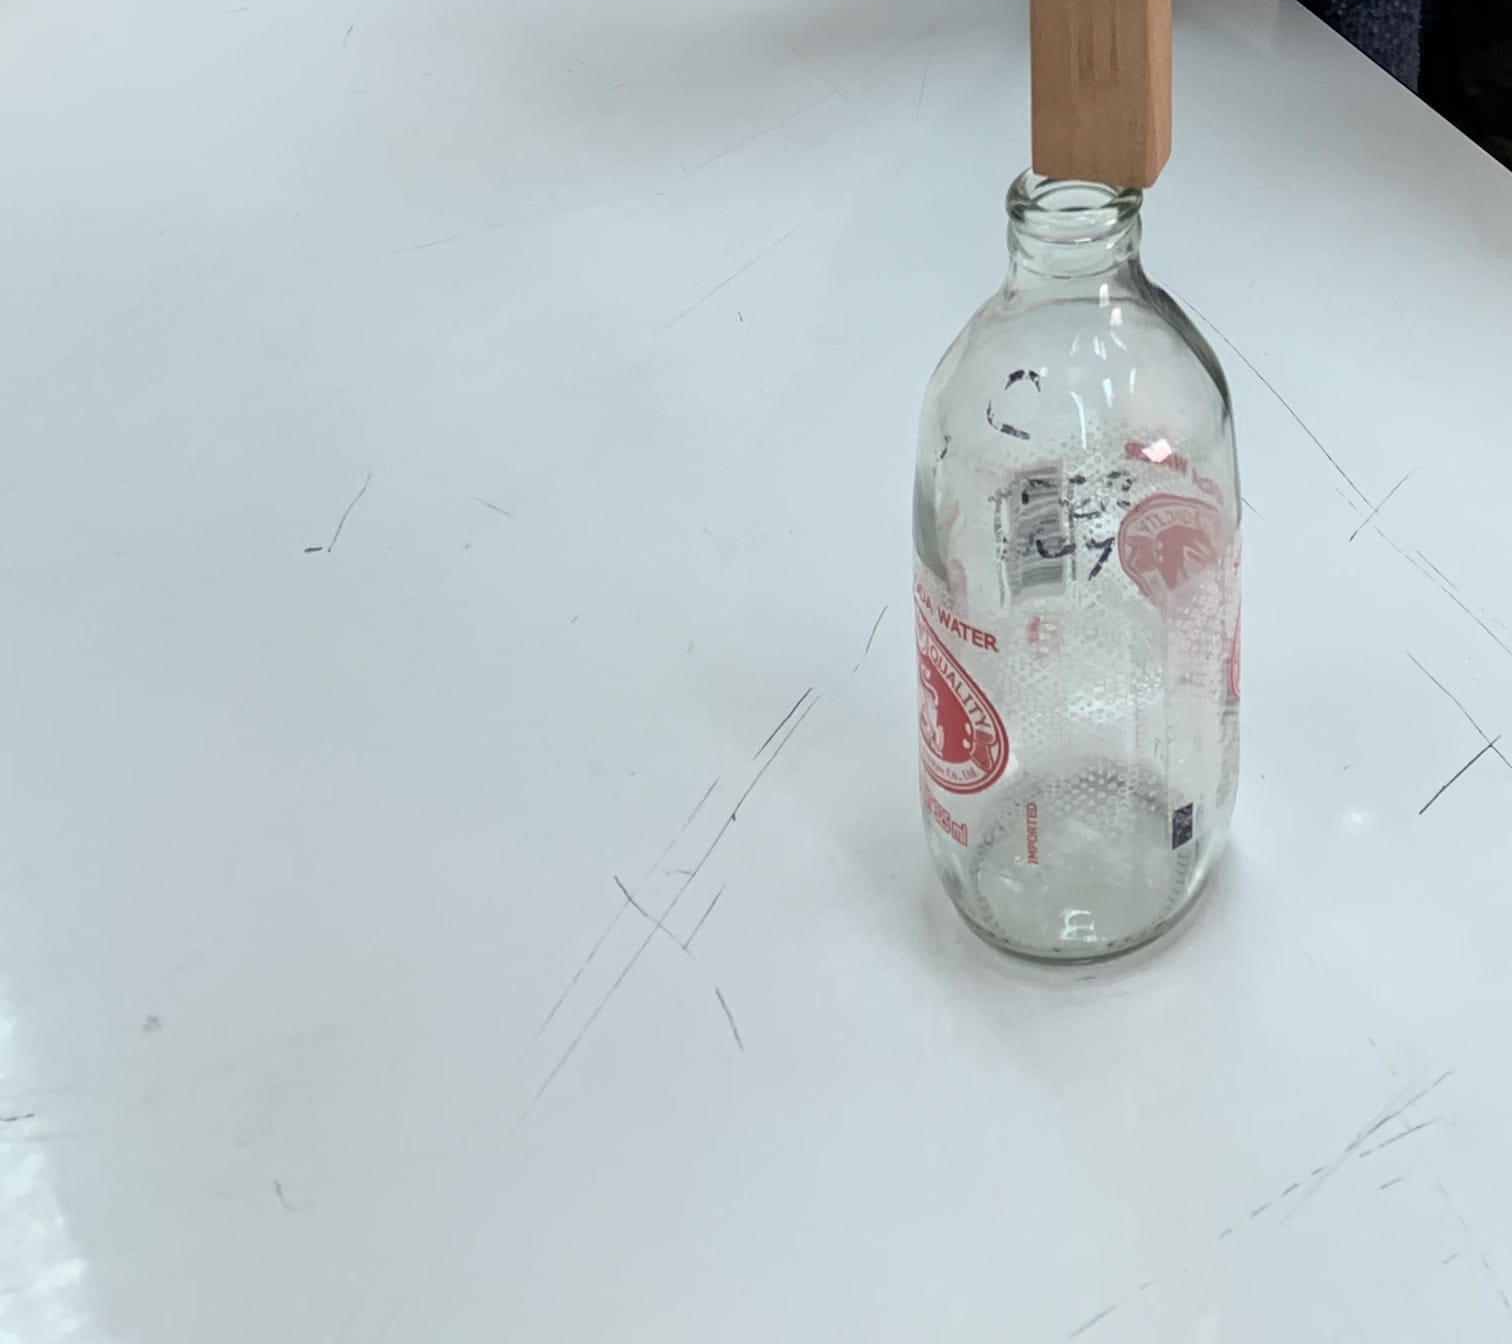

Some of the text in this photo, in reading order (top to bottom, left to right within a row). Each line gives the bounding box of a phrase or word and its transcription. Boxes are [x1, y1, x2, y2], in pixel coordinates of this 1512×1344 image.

[937, 606, 999, 653] WATER
[930, 646, 991, 730] QUALITY
[951, 820, 968, 848] ml
[1027, 802, 1039, 865] IMPORTED
